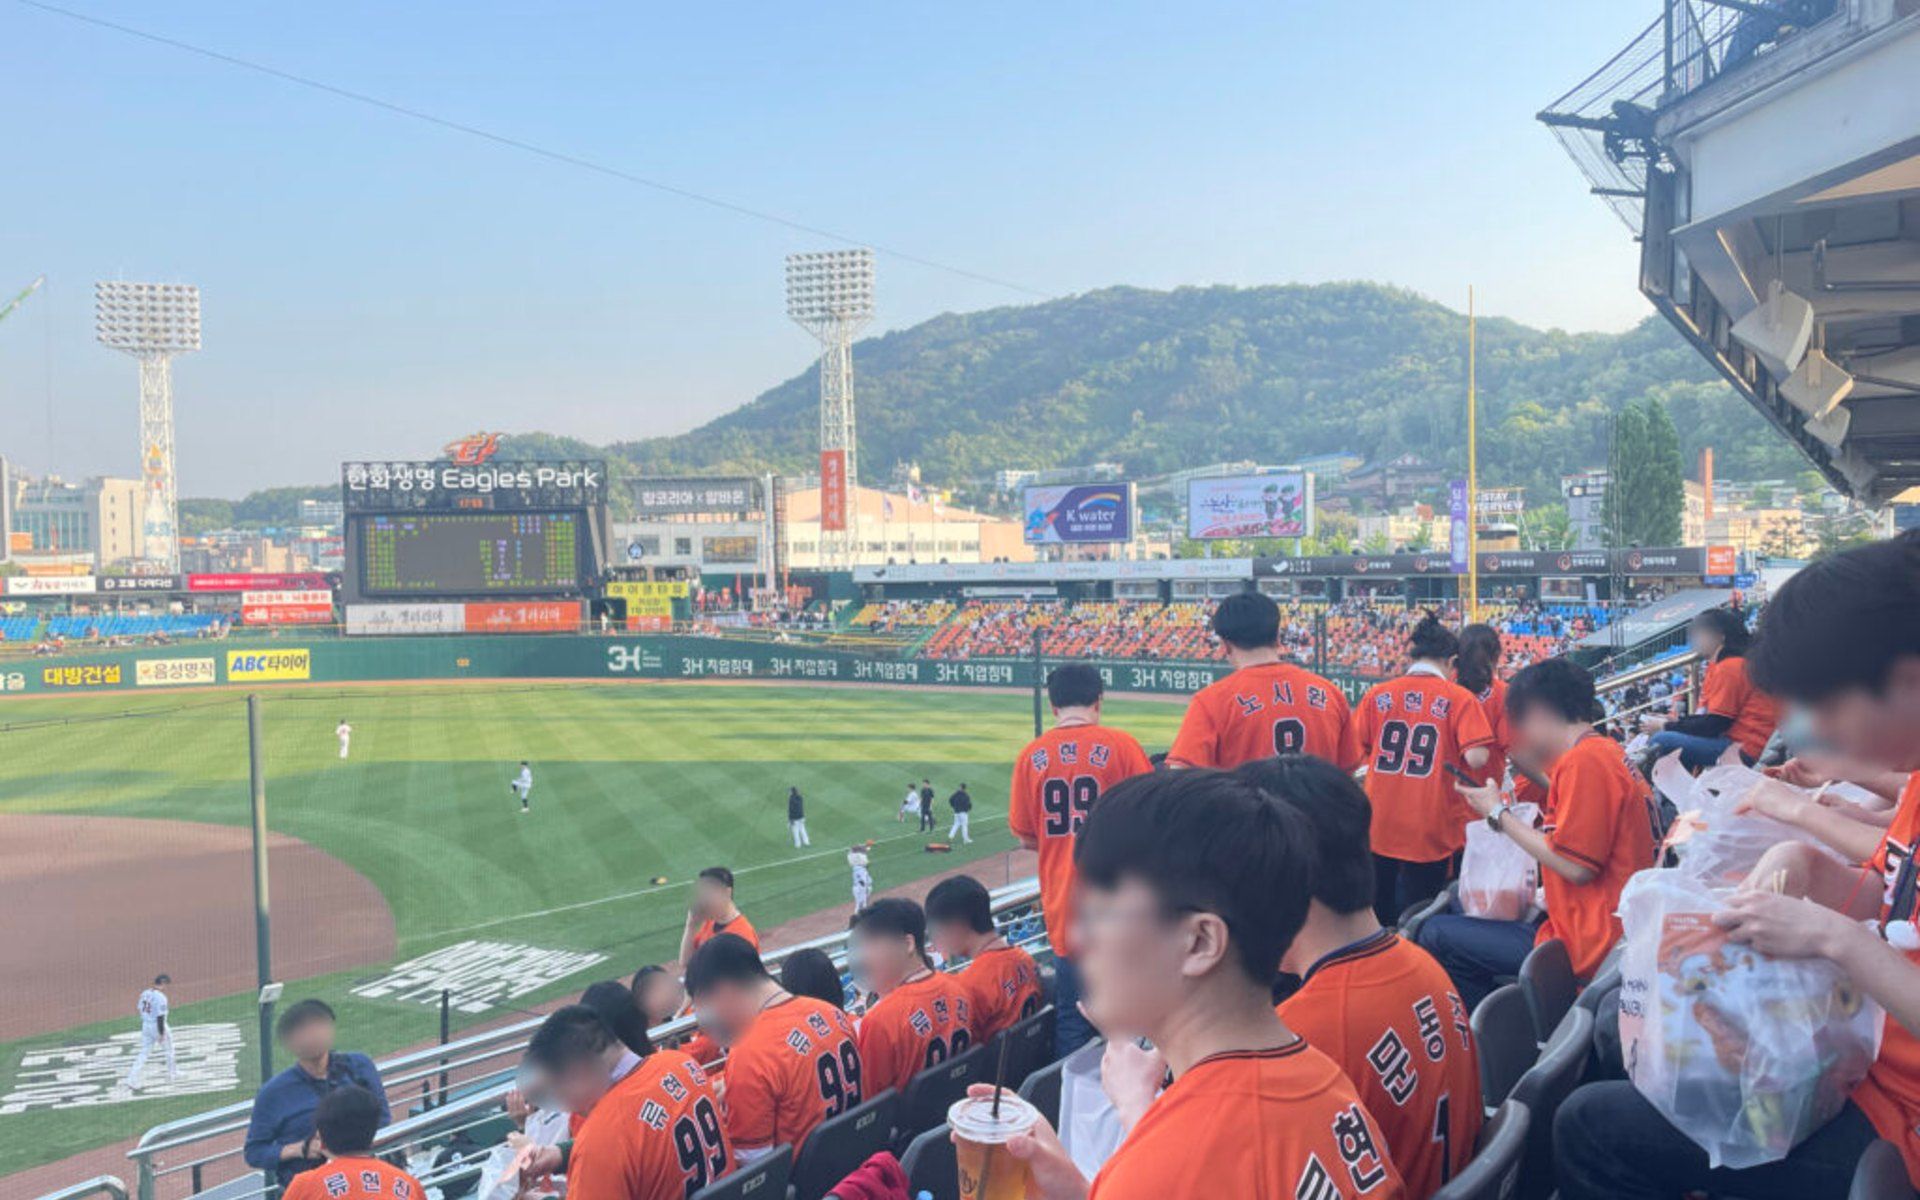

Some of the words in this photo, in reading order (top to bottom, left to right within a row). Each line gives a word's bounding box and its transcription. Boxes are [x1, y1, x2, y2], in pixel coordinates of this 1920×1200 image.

[349, 467, 435, 490] 한화생명
[442, 468, 532, 492] Eagles
[537, 468, 599, 489] Park
[1066, 509, 1076, 522] K
[1079, 509, 1116, 522] water
[44, 665, 121, 685] 대방건설
[682, 657, 702, 675] 3H
[770, 657, 792, 675] 3H
[853, 659, 872, 678] 3H
[875, 661, 919, 681] 지압침대
[935, 662, 960, 682] 3H
[963, 664, 1014, 684] 지압침대
[1131, 667, 1156, 688] 3H
[1160, 670, 1213, 690] 지압침대
[1236, 681, 1328, 717] 노시환
[1375, 691, 1451, 720] 류현진
[1031, 741, 1111, 772] 류현진
[1374, 719, 1441, 778] 99
[1043, 774, 1102, 838] 99
[1366, 991, 1472, 1106] 문동주
[816, 1037, 863, 1121] 99
[673, 1094, 728, 1200] 99
[323, 1169, 412, 1200] 류현진
